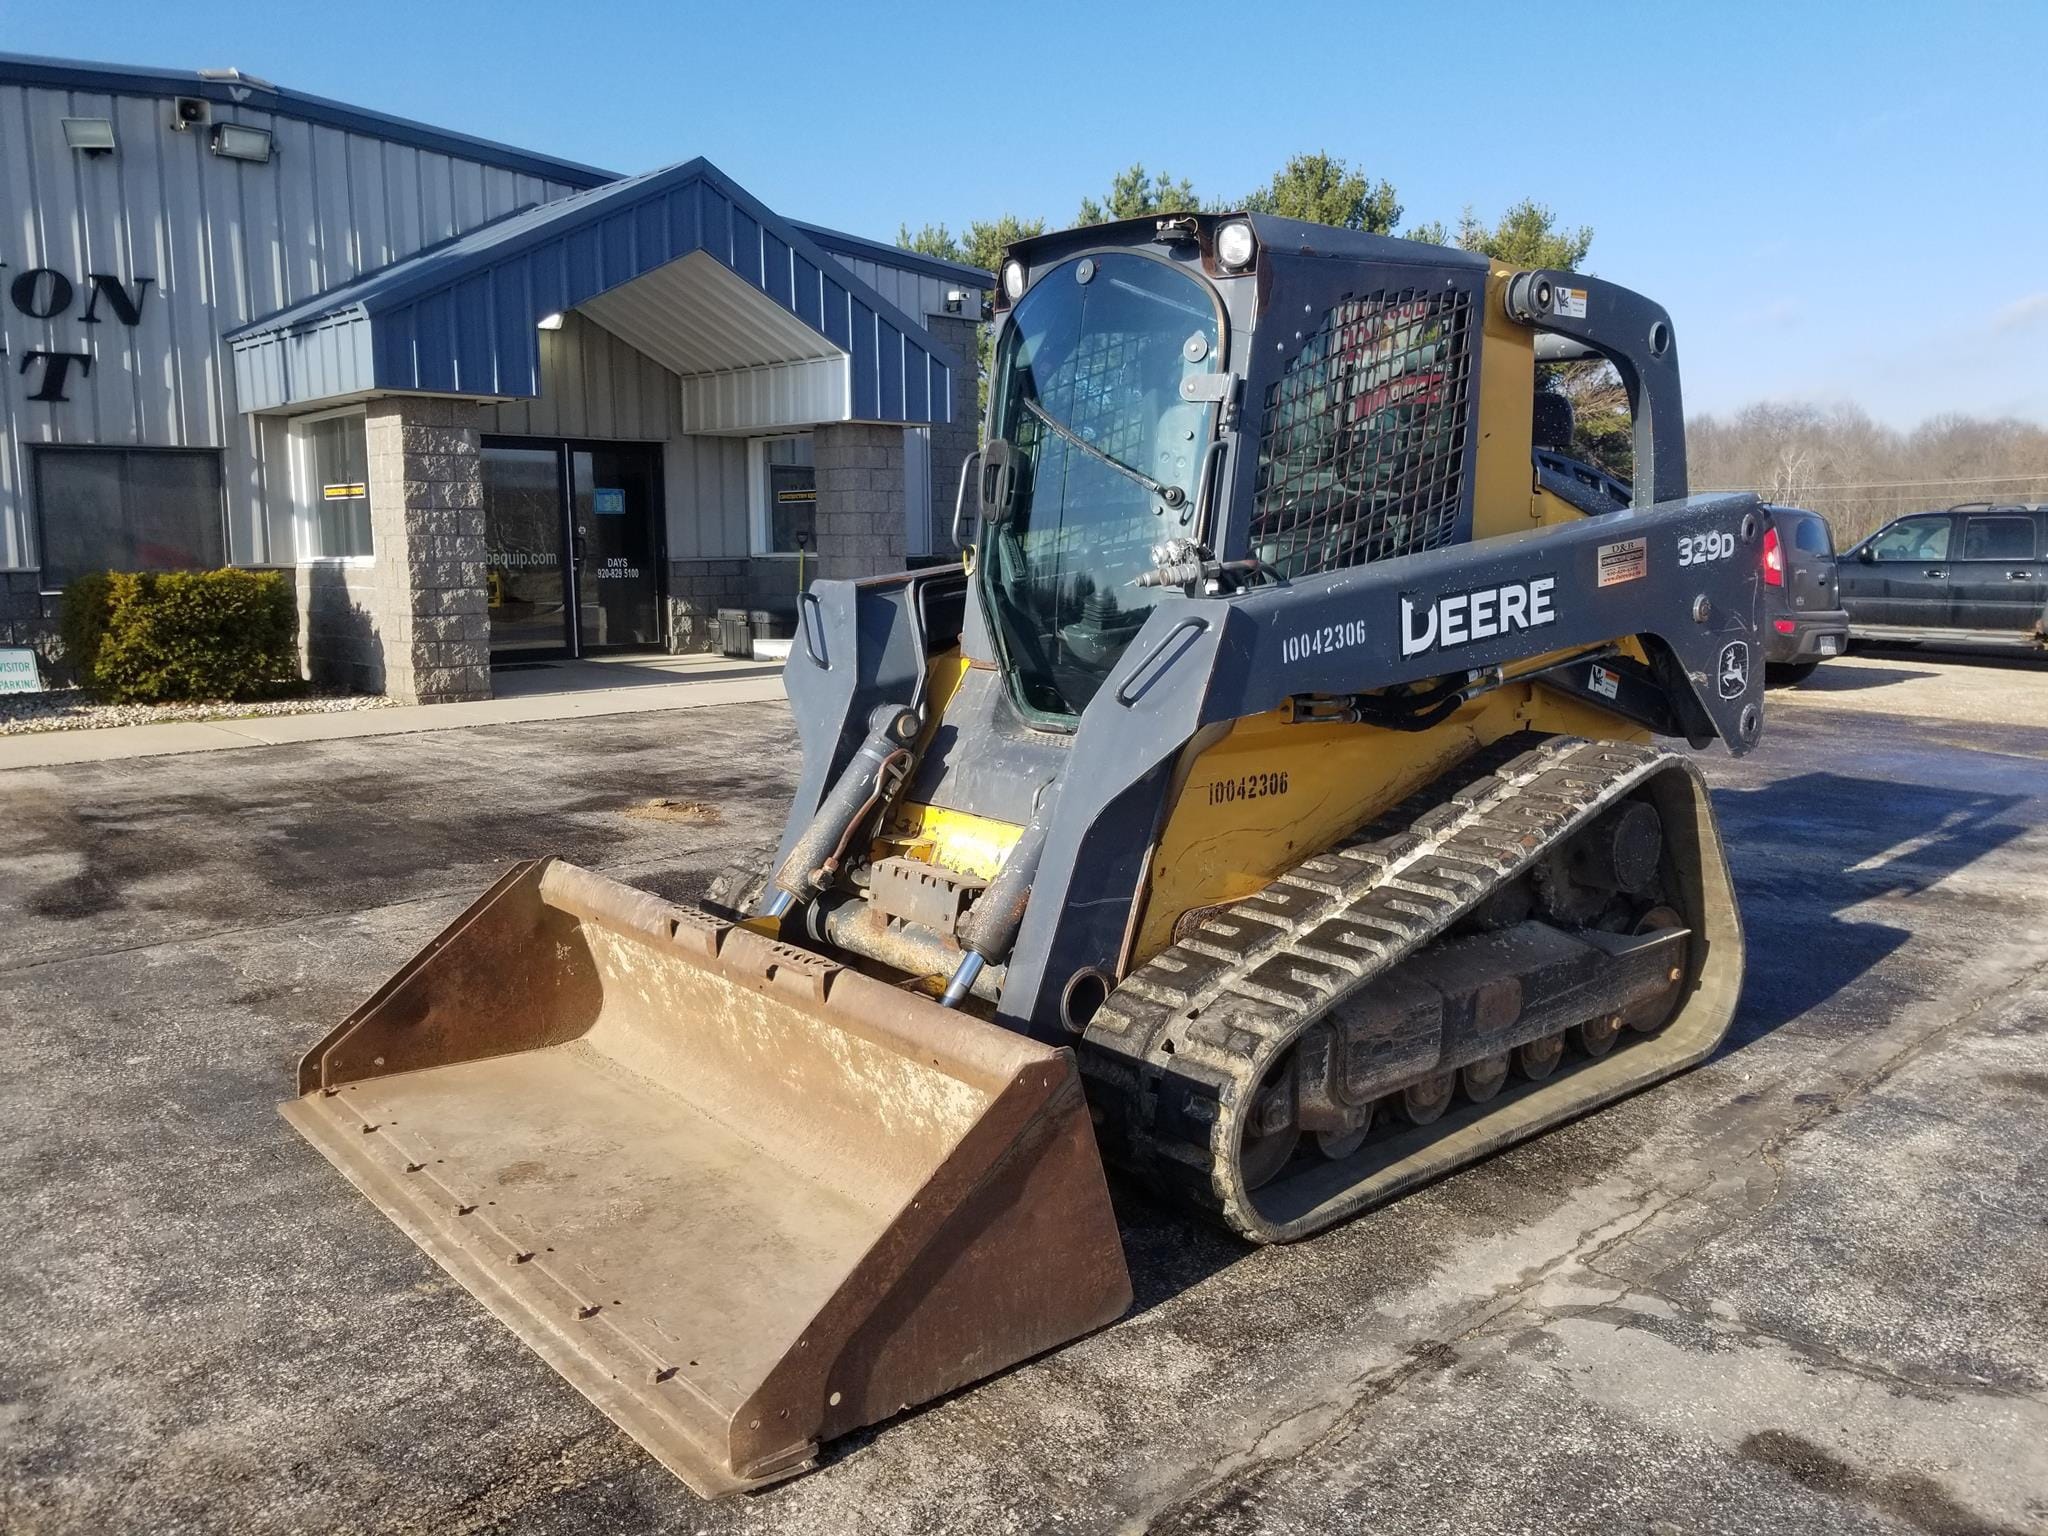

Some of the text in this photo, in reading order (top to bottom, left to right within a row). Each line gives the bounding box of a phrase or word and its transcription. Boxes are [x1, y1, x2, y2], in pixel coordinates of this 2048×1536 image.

[0, 263, 155, 326] ON
[0, 349, 93, 402] T
[607, 558, 628, 568] DAYS
[1678, 530, 1735, 567] 329D
[624, 568, 640, 579] 5100
[1401, 577, 1556, 656] DEERE
[1283, 620, 1366, 664] 10042306
[1209, 771, 1289, 806] 10042306
